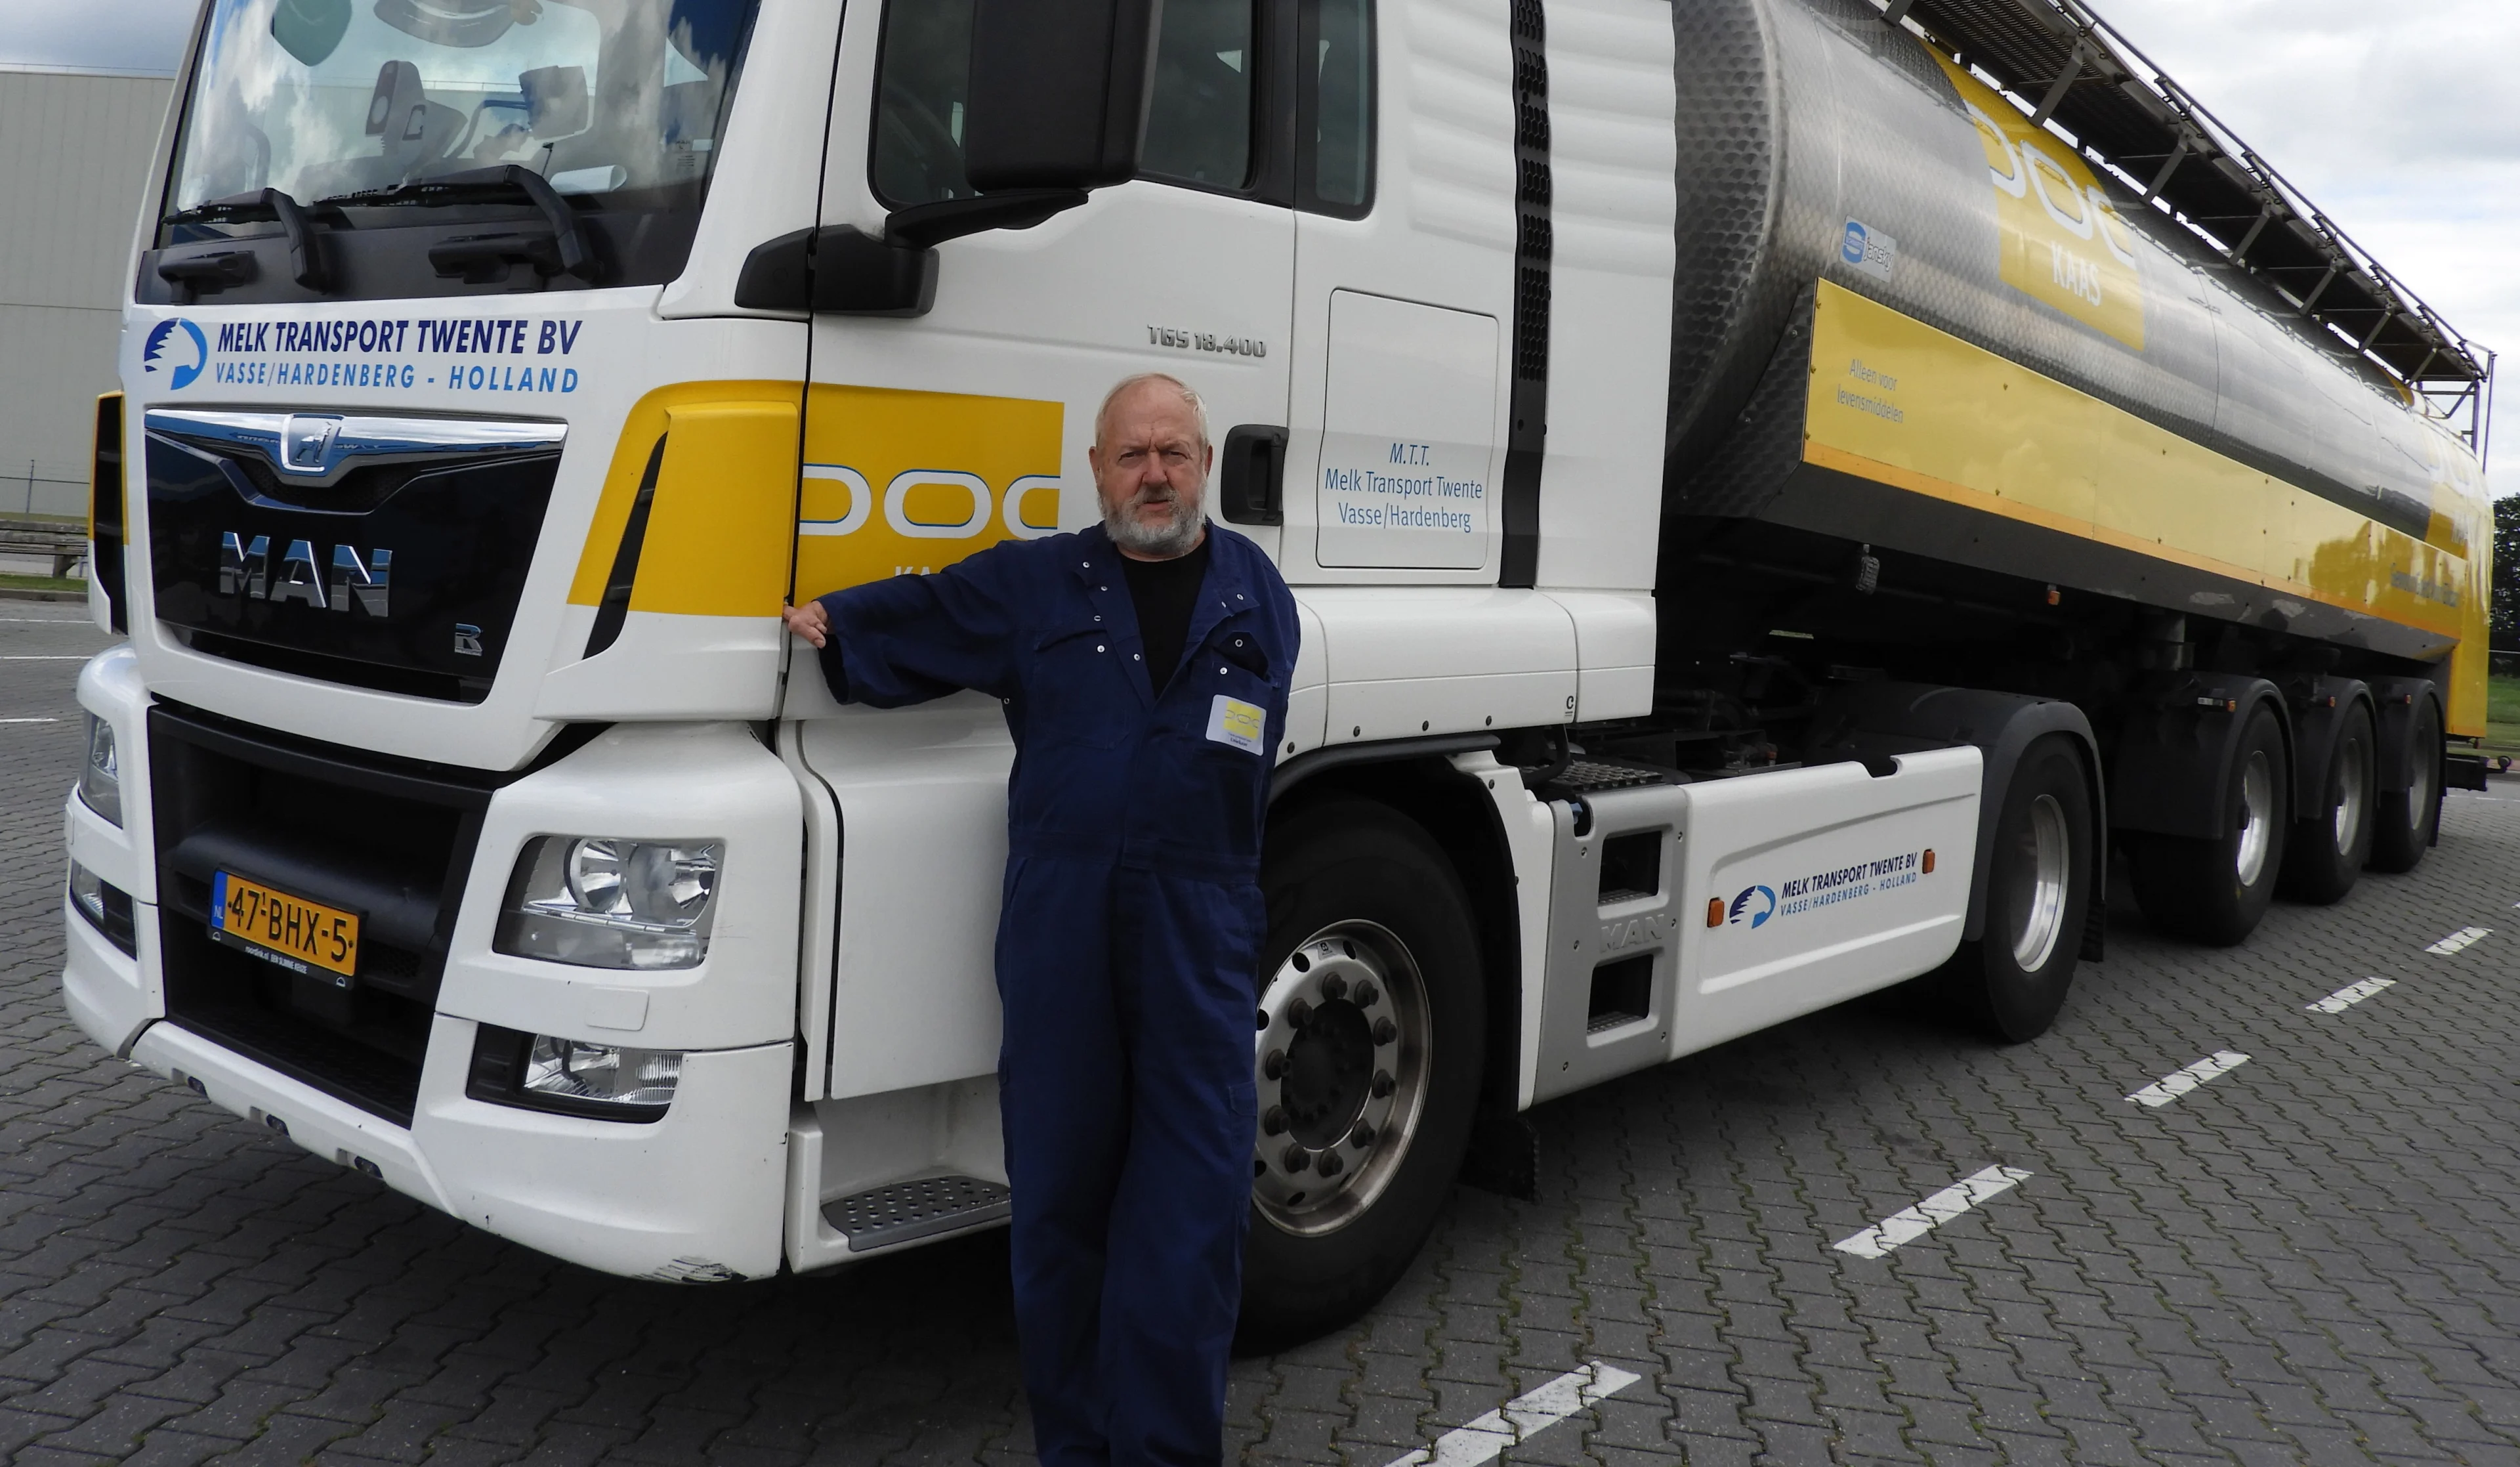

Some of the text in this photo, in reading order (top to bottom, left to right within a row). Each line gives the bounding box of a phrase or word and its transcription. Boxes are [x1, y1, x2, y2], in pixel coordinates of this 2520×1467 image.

[2051, 240, 2101, 307] KAAS
[218, 320, 583, 355] MELK TRANSPORT TWENTE BV
[1147, 324, 1267, 358] TGS 18.400
[216, 362, 415, 389] VASSE/HARDENBERG
[449, 365, 578, 393] HOLLAND
[1849, 358, 1898, 391] Alleen voor
[1838, 383, 1904, 424] levensmiddelen
[1389, 442, 1430, 466] M.T.T.
[1324, 467, 1482, 500] Melk Transport Twente
[1338, 501, 1472, 534] Vasse/Hardenberg
[219, 530, 393, 618] MAN
[1781, 852, 1918, 899] MELK TRANSPORT TWENTE BV
[214, 904, 224, 920] NL
[1780, 883, 1870, 917] VASSE/HARDENBERG
[1880, 872, 1917, 891] HOLLAND
[231, 886, 348, 962] 47-BHX-5
[1599, 913, 1665, 954] MAN
